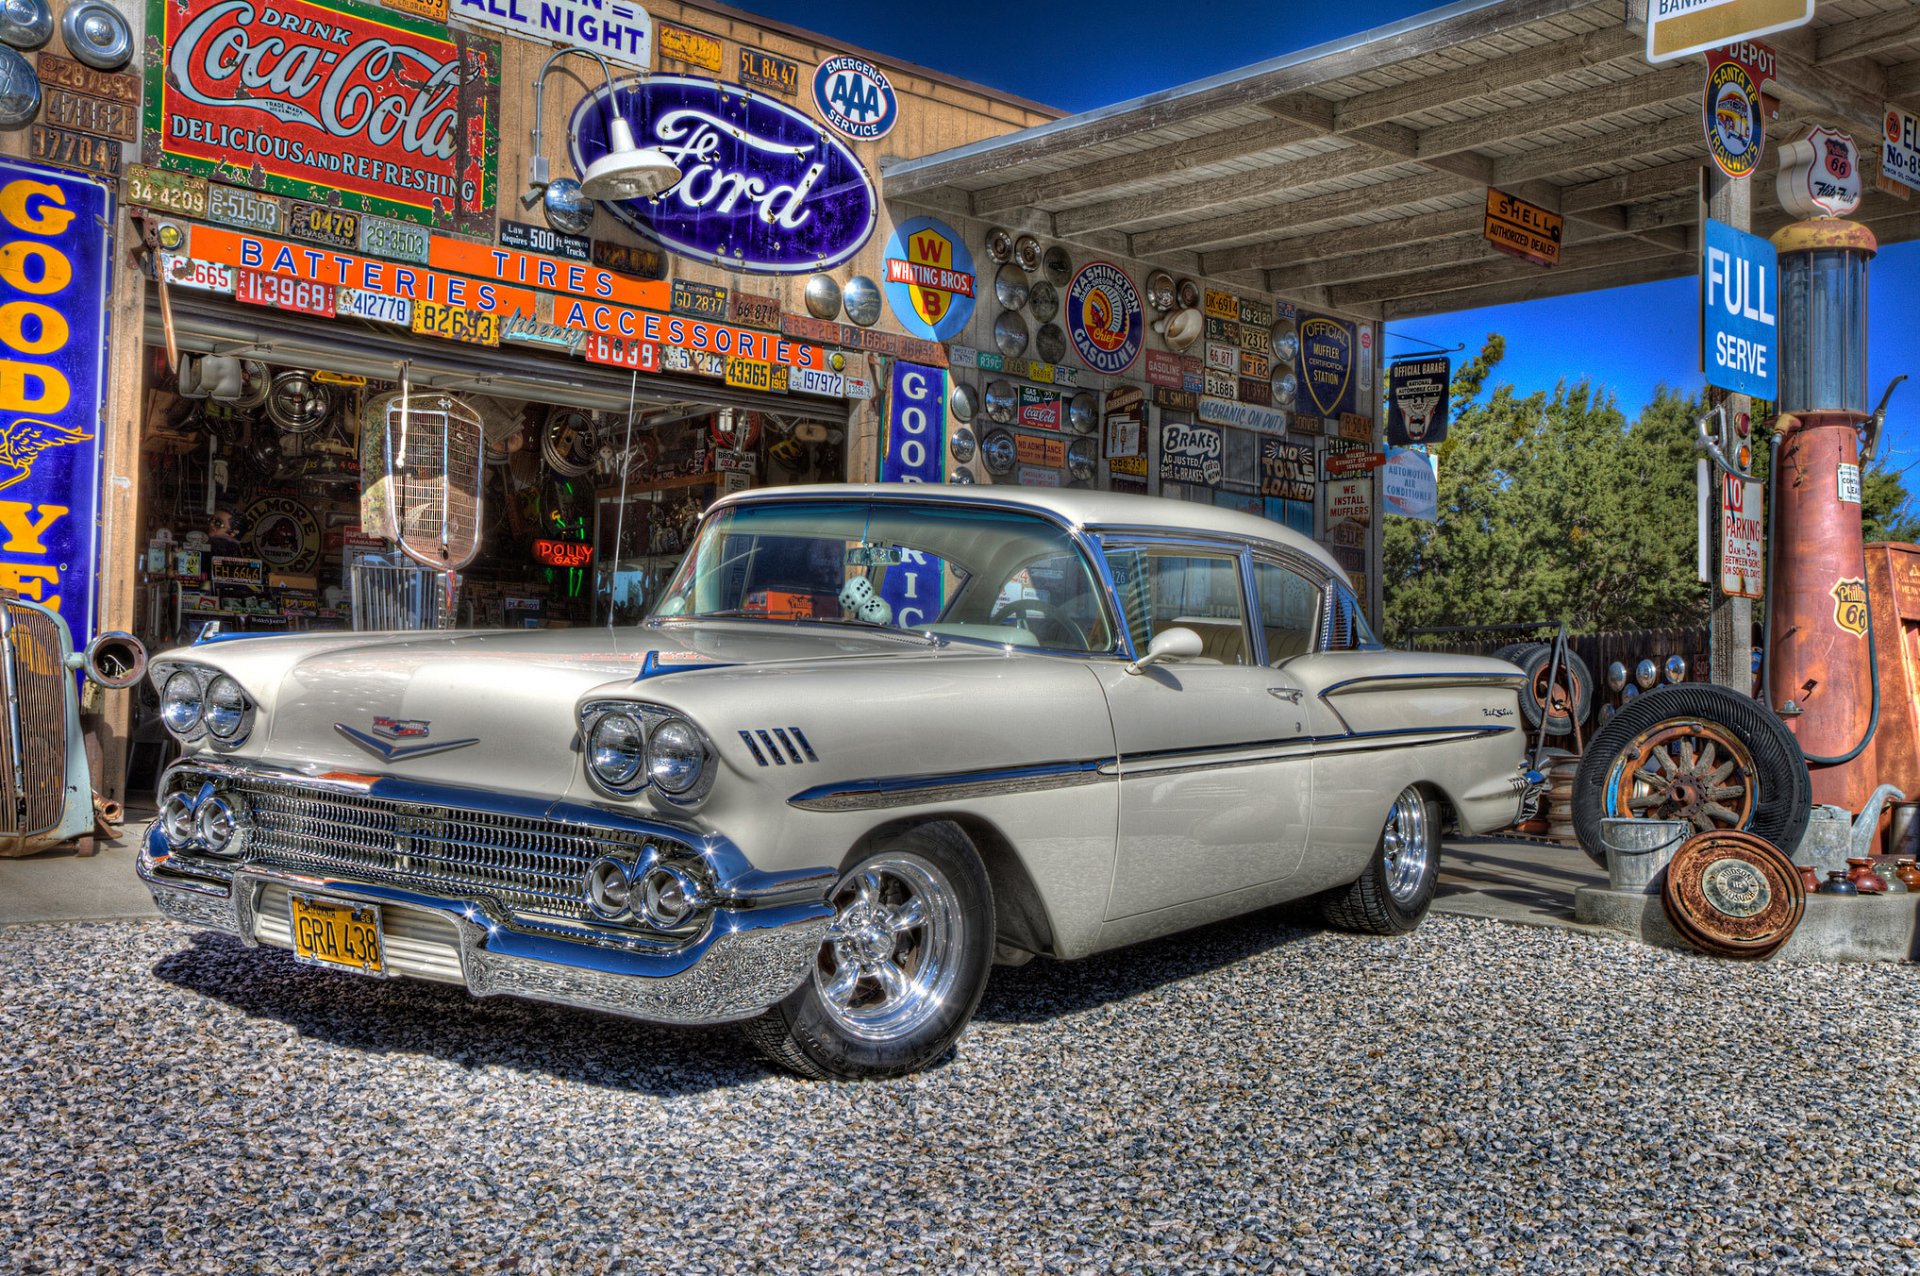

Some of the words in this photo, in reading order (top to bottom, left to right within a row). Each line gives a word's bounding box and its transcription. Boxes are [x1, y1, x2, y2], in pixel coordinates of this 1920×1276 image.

[259, 7, 352, 46] DRINK
[541, 2, 644, 55] NIGHT
[1730, 41, 1775, 76] DEPOT
[169, 0, 481, 164] Coca-Cola
[761, 59, 778, 80] 84
[781, 66, 797, 87] 47
[826, 58, 889, 91] EMERGENCY
[1713, 66, 1745, 90] SANTA
[1746, 83, 1759, 106] FE
[830, 72, 880, 123] AAA
[828, 108, 879, 136] SERVICE
[171, 114, 304, 163] DELICIOUS
[304, 152, 342, 173] AND
[341, 152, 475, 202] REFRESHING
[1709, 128, 1759, 171] TRAILWAYS
[643, 110, 826, 229] Ford
[1831, 158, 1847, 176] 66
[310, 209, 355, 238] 0479
[1499, 200, 1552, 232] SHELL
[366, 225, 424, 257] 29-3503
[501, 232, 528, 246] Requires
[508, 224, 523, 235] Law
[530, 229, 555, 251] 500
[1490, 223, 1529, 247] AUTHORIZED
[1531, 238, 1556, 256] DEALER
[566, 246, 586, 258] Trucks
[916, 237, 943, 263] W
[240, 238, 498, 311] BATTERIES
[491, 250, 613, 297] TIRES
[891, 260, 939, 286] WHITING
[940, 270, 970, 292] BROS.
[1708, 246, 1775, 326] FULL
[250, 272, 325, 312] 113968
[674, 291, 691, 308] GD
[695, 295, 723, 314] 2837
[1071, 266, 1140, 313] WASHINGTON
[354, 293, 406, 322] 412778
[922, 290, 941, 316] B
[424, 305, 492, 341] 82693
[503, 306, 584, 357] Liberty
[565, 301, 814, 368] ACCESSORIES
[1306, 322, 1346, 347] OFFICIAL
[1074, 328, 1136, 370] GASOLINE
[1092, 328, 1125, 349] Chief
[1313, 343, 1340, 360] MUFFLER
[1308, 358, 1344, 371] CERTIFICATION
[1716, 331, 1767, 378] SERVE
[728, 361, 768, 387] 43365
[1148, 360, 1180, 377] GASOLINE
[1313, 369, 1339, 385] STATION
[1394, 364, 1421, 378] OFFICIAL
[1422, 361, 1447, 375] GARAGE
[772, 377, 787, 390] 1913
[804, 371, 842, 395] 197972
[1025, 387, 1037, 395] GAS
[1023, 394, 1040, 403] TODAY
[1170, 390, 1194, 409] SMITH
[1200, 401, 1245, 425] MECHANIC
[1248, 410, 1264, 426] ON
[1264, 412, 1284, 430] DUTY
[1165, 427, 1219, 454] BRAKES
[1279, 445, 1298, 460] NO
[1163, 452, 1204, 468] ADJUSTED!
[1346, 451, 1365, 459] WALKER
[1262, 457, 1315, 483] TOOLS
[1404, 478, 1416, 488] AIR
[1261, 476, 1315, 501] LOANED
[1334, 496, 1365, 506] INSTALL
[1343, 485, 1356, 494] WE
[1724, 475, 1742, 508] NO
[1330, 506, 1369, 517] MUFFLERS
[1725, 516, 1761, 542] PARKING
[553, 556, 580, 566] GAS
[1725, 554, 1748, 568] BETWEEN
[1748, 557, 1760, 569] SIGNS
[1725, 564, 1732, 575] ON
[1750, 567, 1760, 579] DAYS
[1846, 604, 1867, 629] 66
[1720, 867, 1753, 881] HUDSON
[300, 916, 339, 957] GRA
[344, 922, 378, 963] 438
